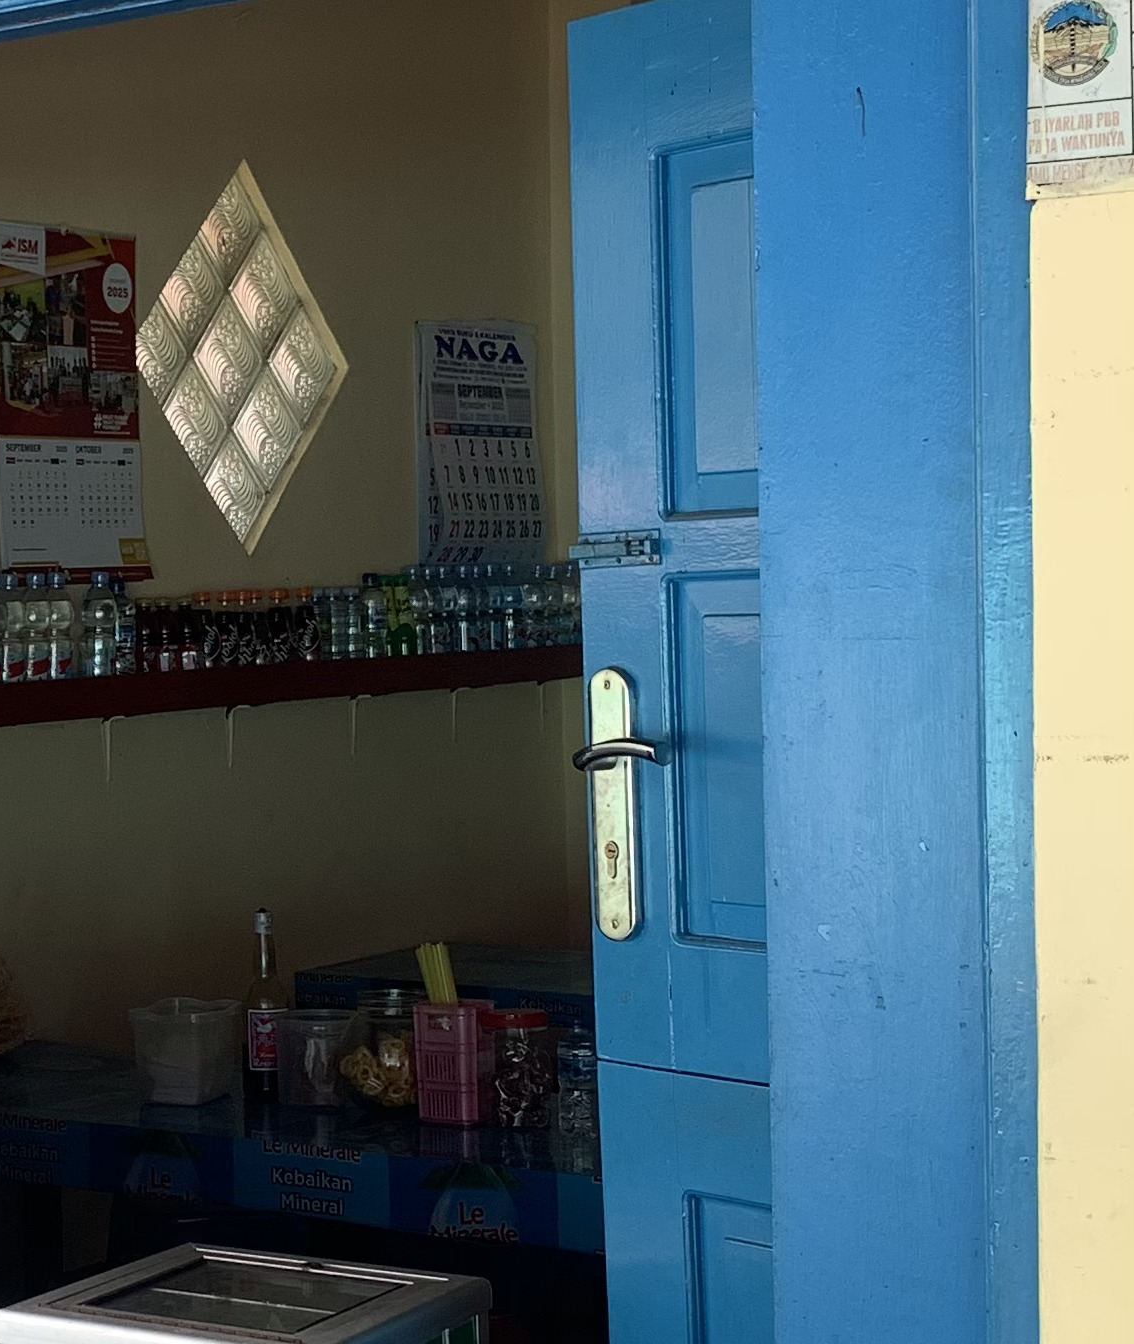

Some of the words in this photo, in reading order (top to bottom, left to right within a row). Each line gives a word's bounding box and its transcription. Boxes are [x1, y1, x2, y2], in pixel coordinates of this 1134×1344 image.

[17, 238, 39, 256] ISM
[106, 286, 129, 300] 2025
[434, 335, 524, 365] NAGA
[457, 383, 503, 399] SEPTEMBER
[469, 439, 475, 456] 2
[483, 440, 489, 457] 3
[485, 466, 495, 484] 10
[499, 467, 509, 484] 11
[513, 467, 523, 485] 12
[526, 468, 536, 485] 13
[448, 492, 458, 511] 14
[462, 493, 472, 511] 15
[490, 493, 500, 511] 17
[449, 520, 460, 538] 21
[464, 520, 475, 538] 22
[478, 520, 488, 538] 23
[493, 520, 502, 538] 24
[533, 521, 541, 538] 27
[150, 1167, 172, 1190] Le
[270, 1166, 354, 1193] Kebaikan
[280, 1192, 345, 1216] Mineral
[458, 1201, 485, 1226] Le
